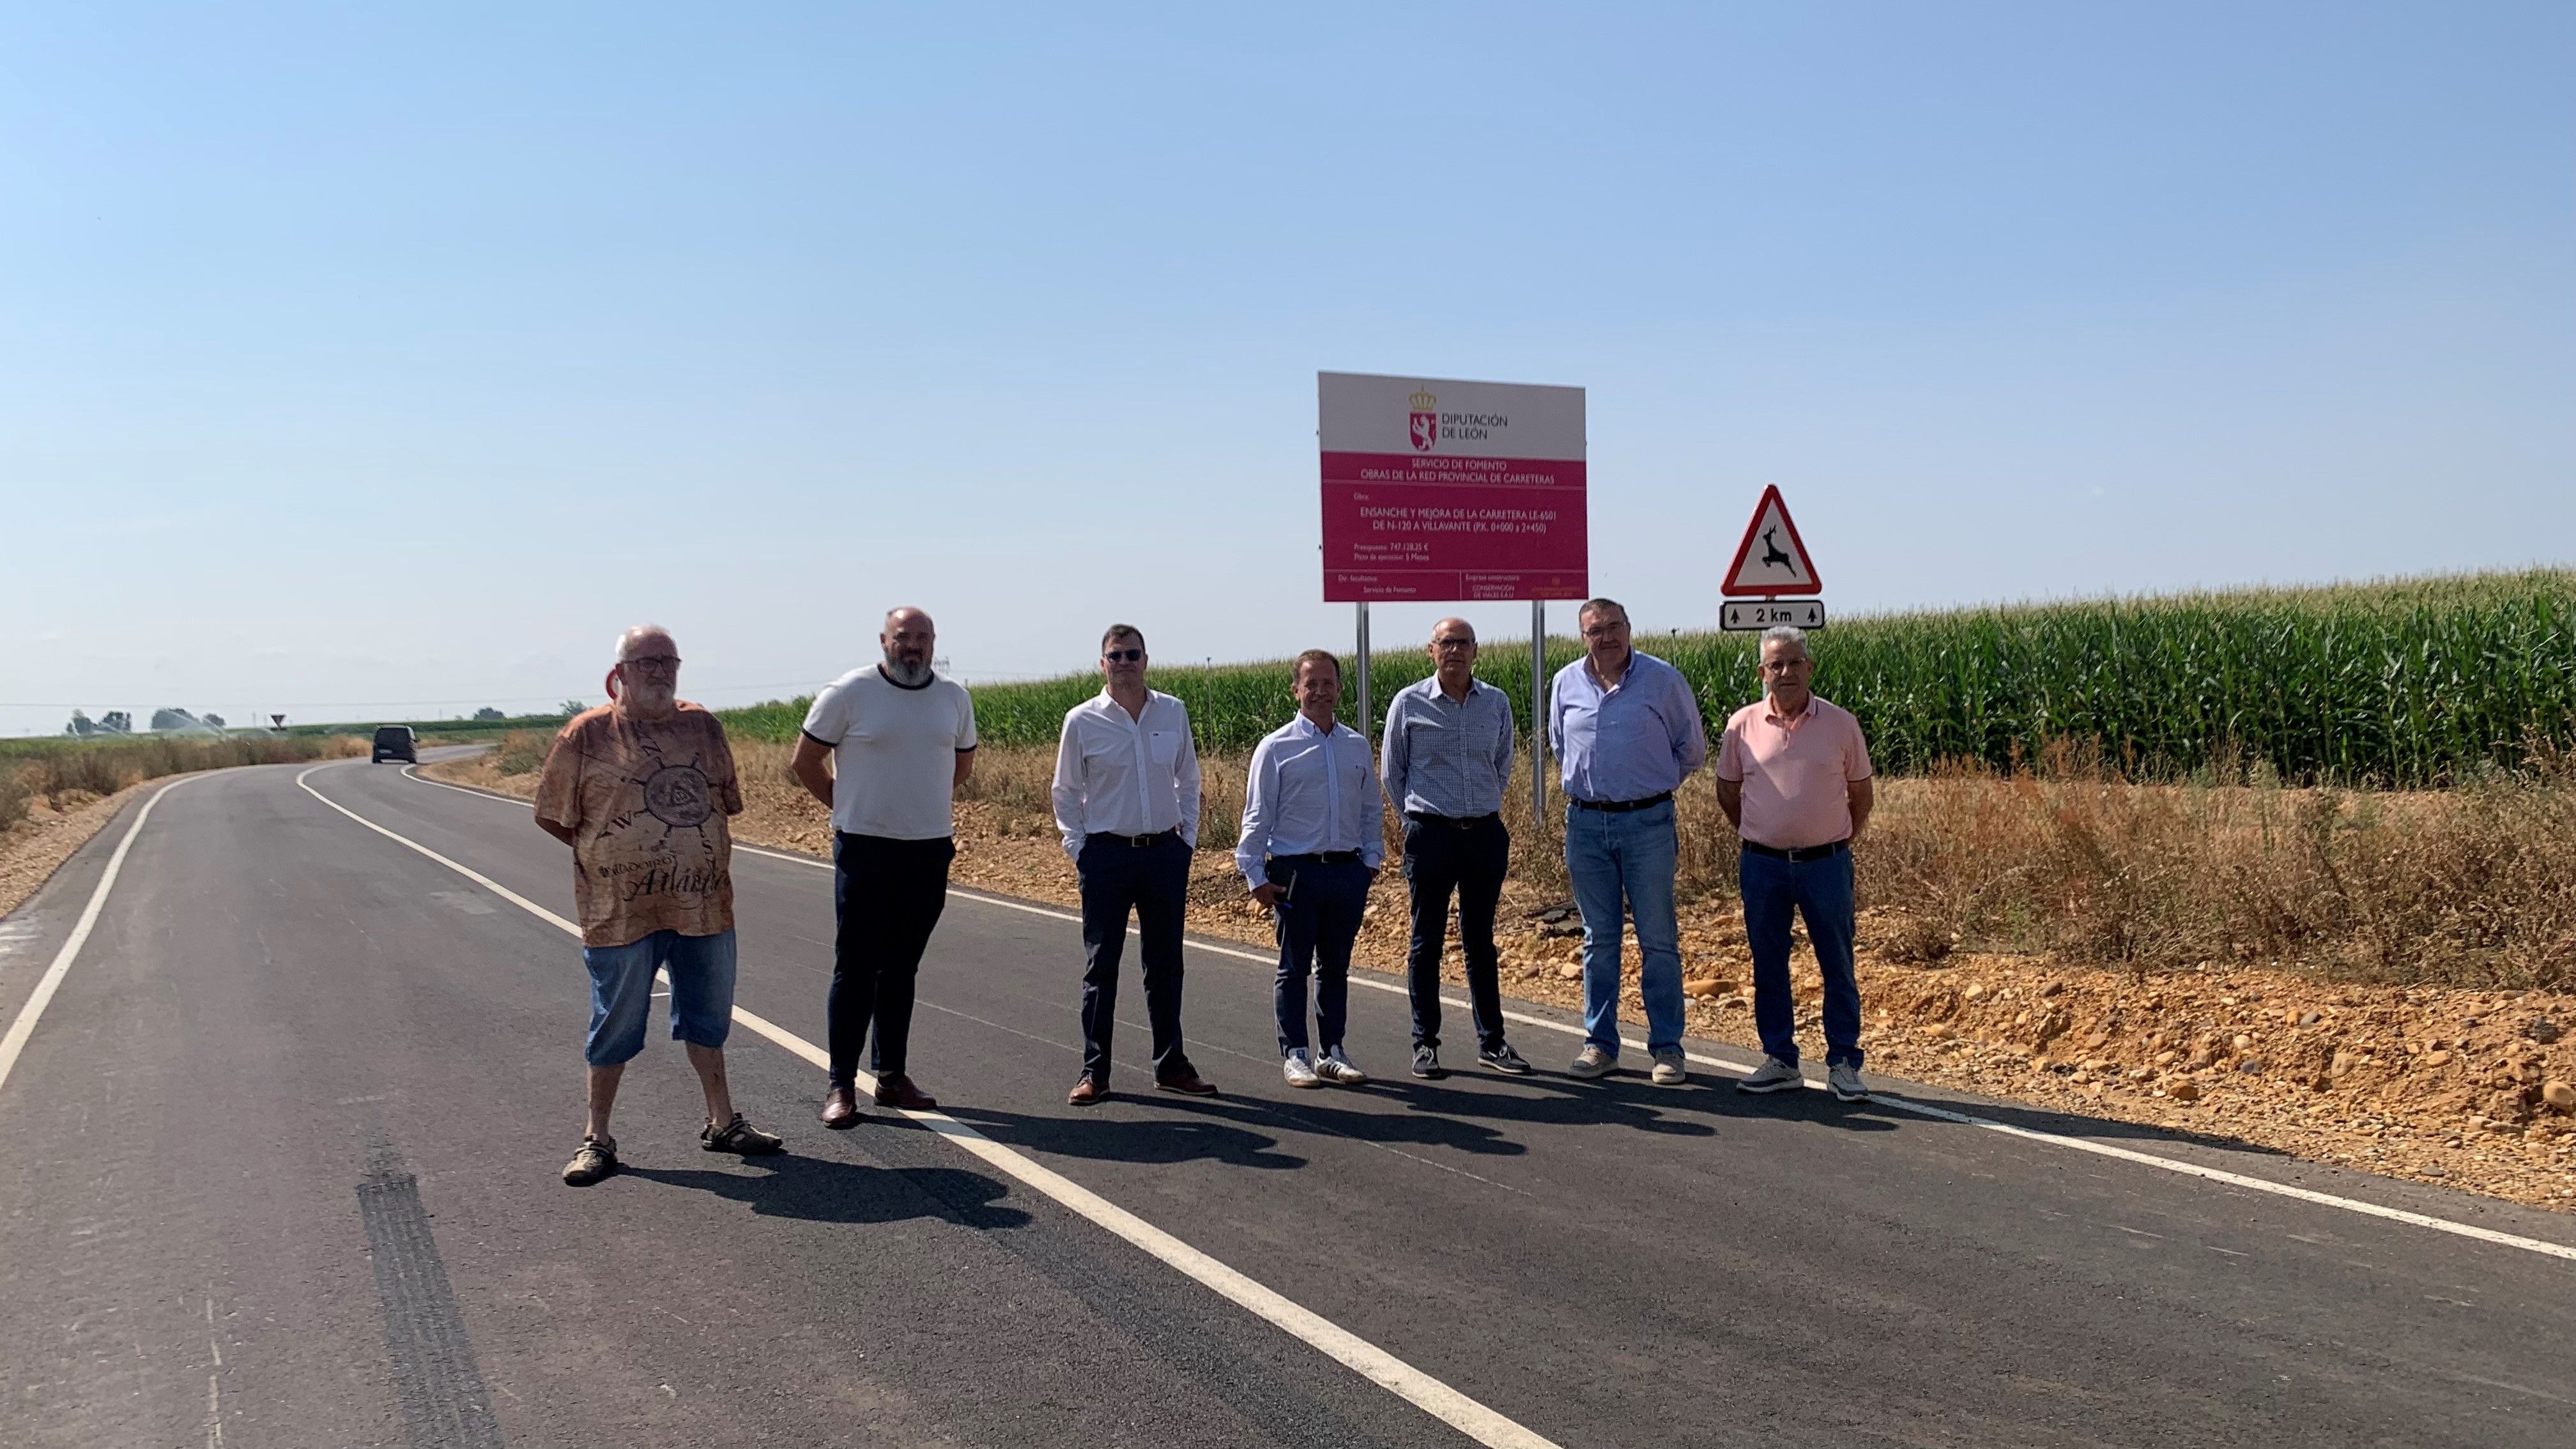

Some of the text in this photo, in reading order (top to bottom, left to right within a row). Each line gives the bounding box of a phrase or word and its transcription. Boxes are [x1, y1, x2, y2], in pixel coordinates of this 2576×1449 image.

[1442, 412, 1508, 427] DIPUTACIÓN
[1442, 426, 1487, 440] DE LEÓN
[1412, 457, 1507, 471] SERVICIO DE FOMENTO
[1361, 468, 1554, 486] OBRAS DE LA RED PROVINCIAL DE CARRETERAS
[1360, 506, 1556, 521] ENSANCHE Y MEJORA DE LA CARRETERA LE-6501
[1372, 519, 1385, 531] DE
[1387, 520, 1411, 532] N-120
[1413, 521, 1420, 532] A
[1422, 520, 1471, 533] VILLAVANTE
[1491, 522, 1514, 533] 0+000
[1521, 521, 1547, 535] 2+450)
[1756, 608, 1791, 622] 2 km
